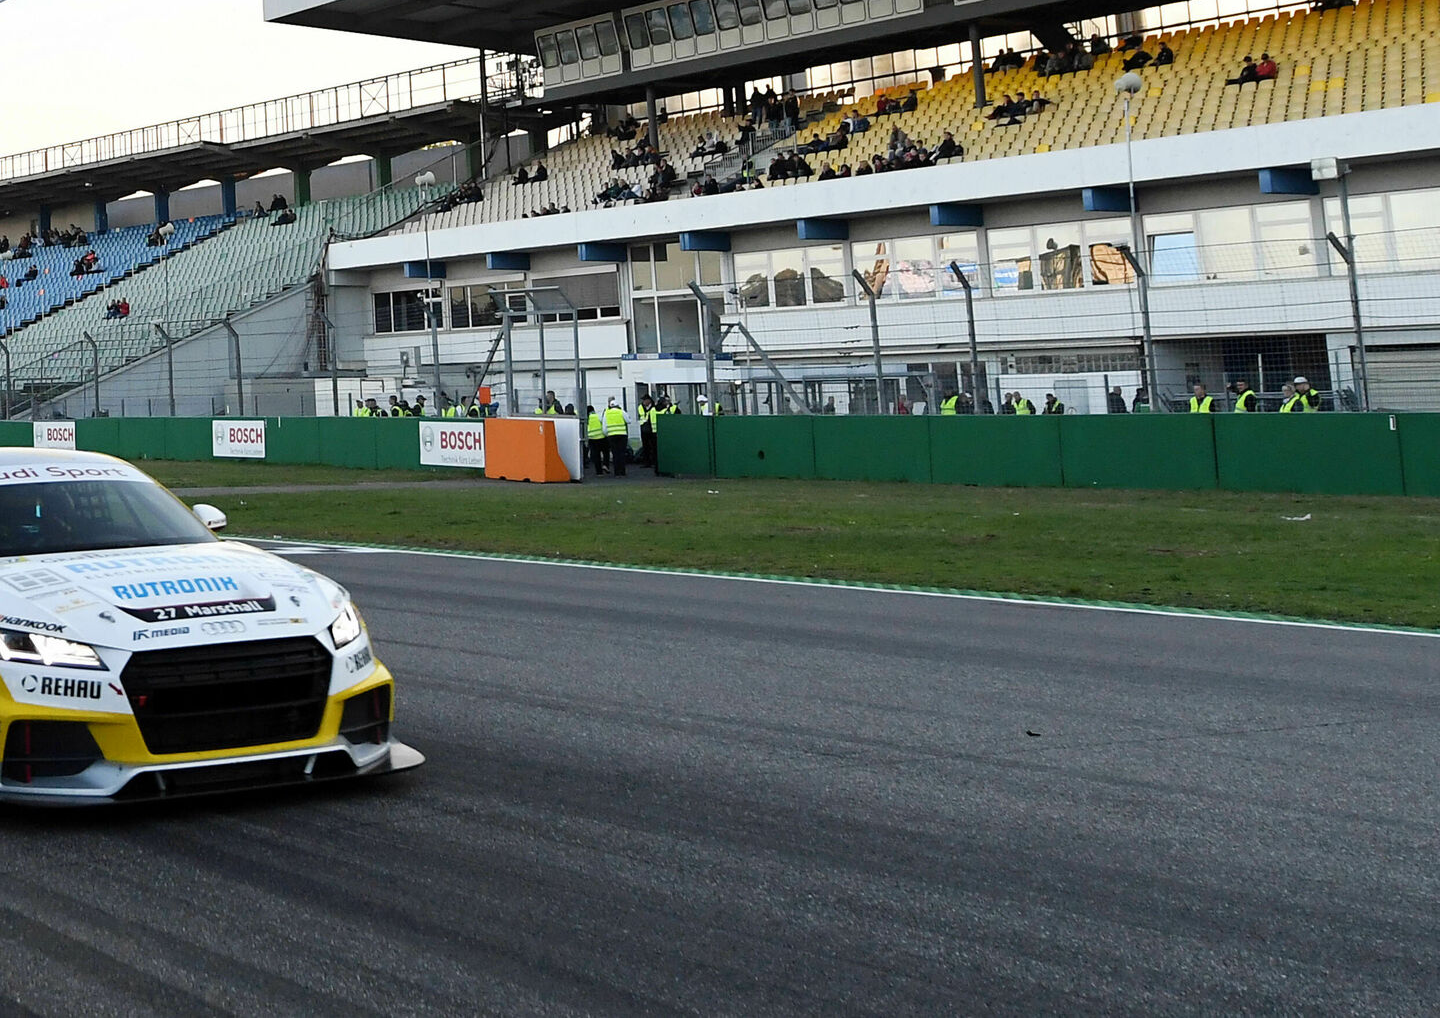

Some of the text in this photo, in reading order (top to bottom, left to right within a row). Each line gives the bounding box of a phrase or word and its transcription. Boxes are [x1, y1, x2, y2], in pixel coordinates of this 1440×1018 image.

[47, 428, 74, 441] BOSCH
[229, 427, 263, 443] BOSCH
[440, 430, 482, 450] BOSCH
[45, 466, 128, 480] Sport
[112, 577, 238, 600] RUTRONIK
[153, 600, 264, 620] 27 Marschall
[41, 676, 102, 699] REHAU
